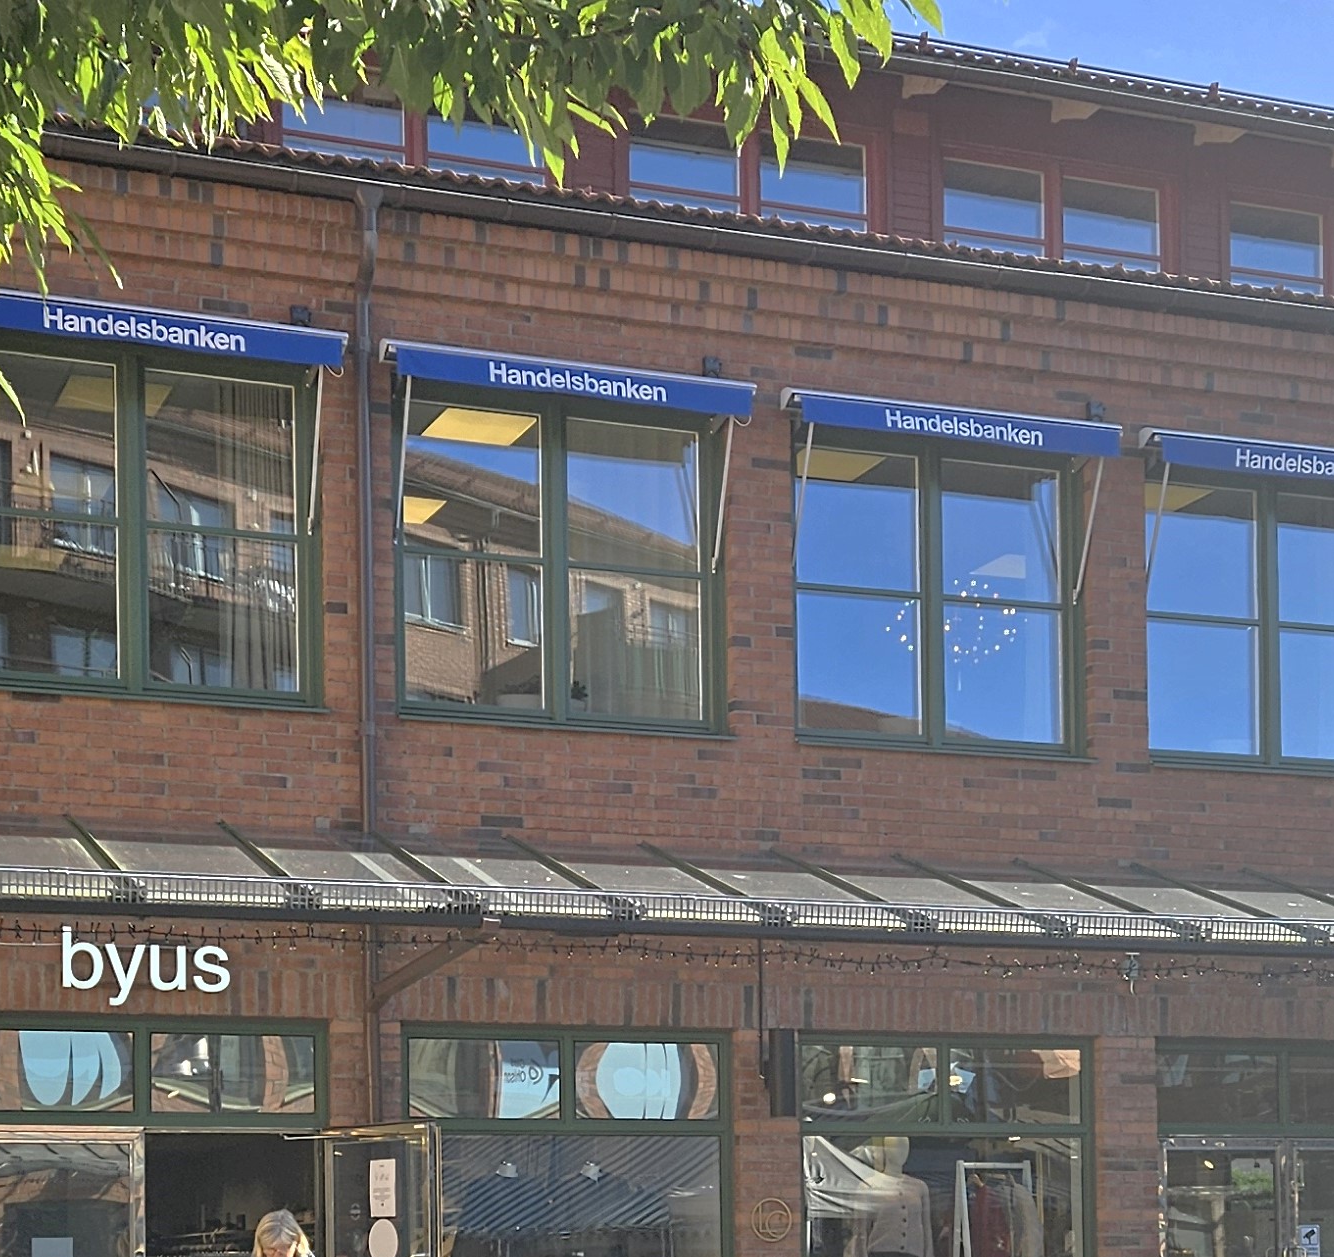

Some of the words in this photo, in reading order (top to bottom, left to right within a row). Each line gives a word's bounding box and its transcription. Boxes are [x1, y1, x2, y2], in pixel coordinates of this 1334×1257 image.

[42, 305, 246, 352] Handelsbanken
[489, 361, 667, 402] Handelsbanken
[885, 409, 1043, 446] Handelsbanken
[62, 925, 231, 1006] byus
